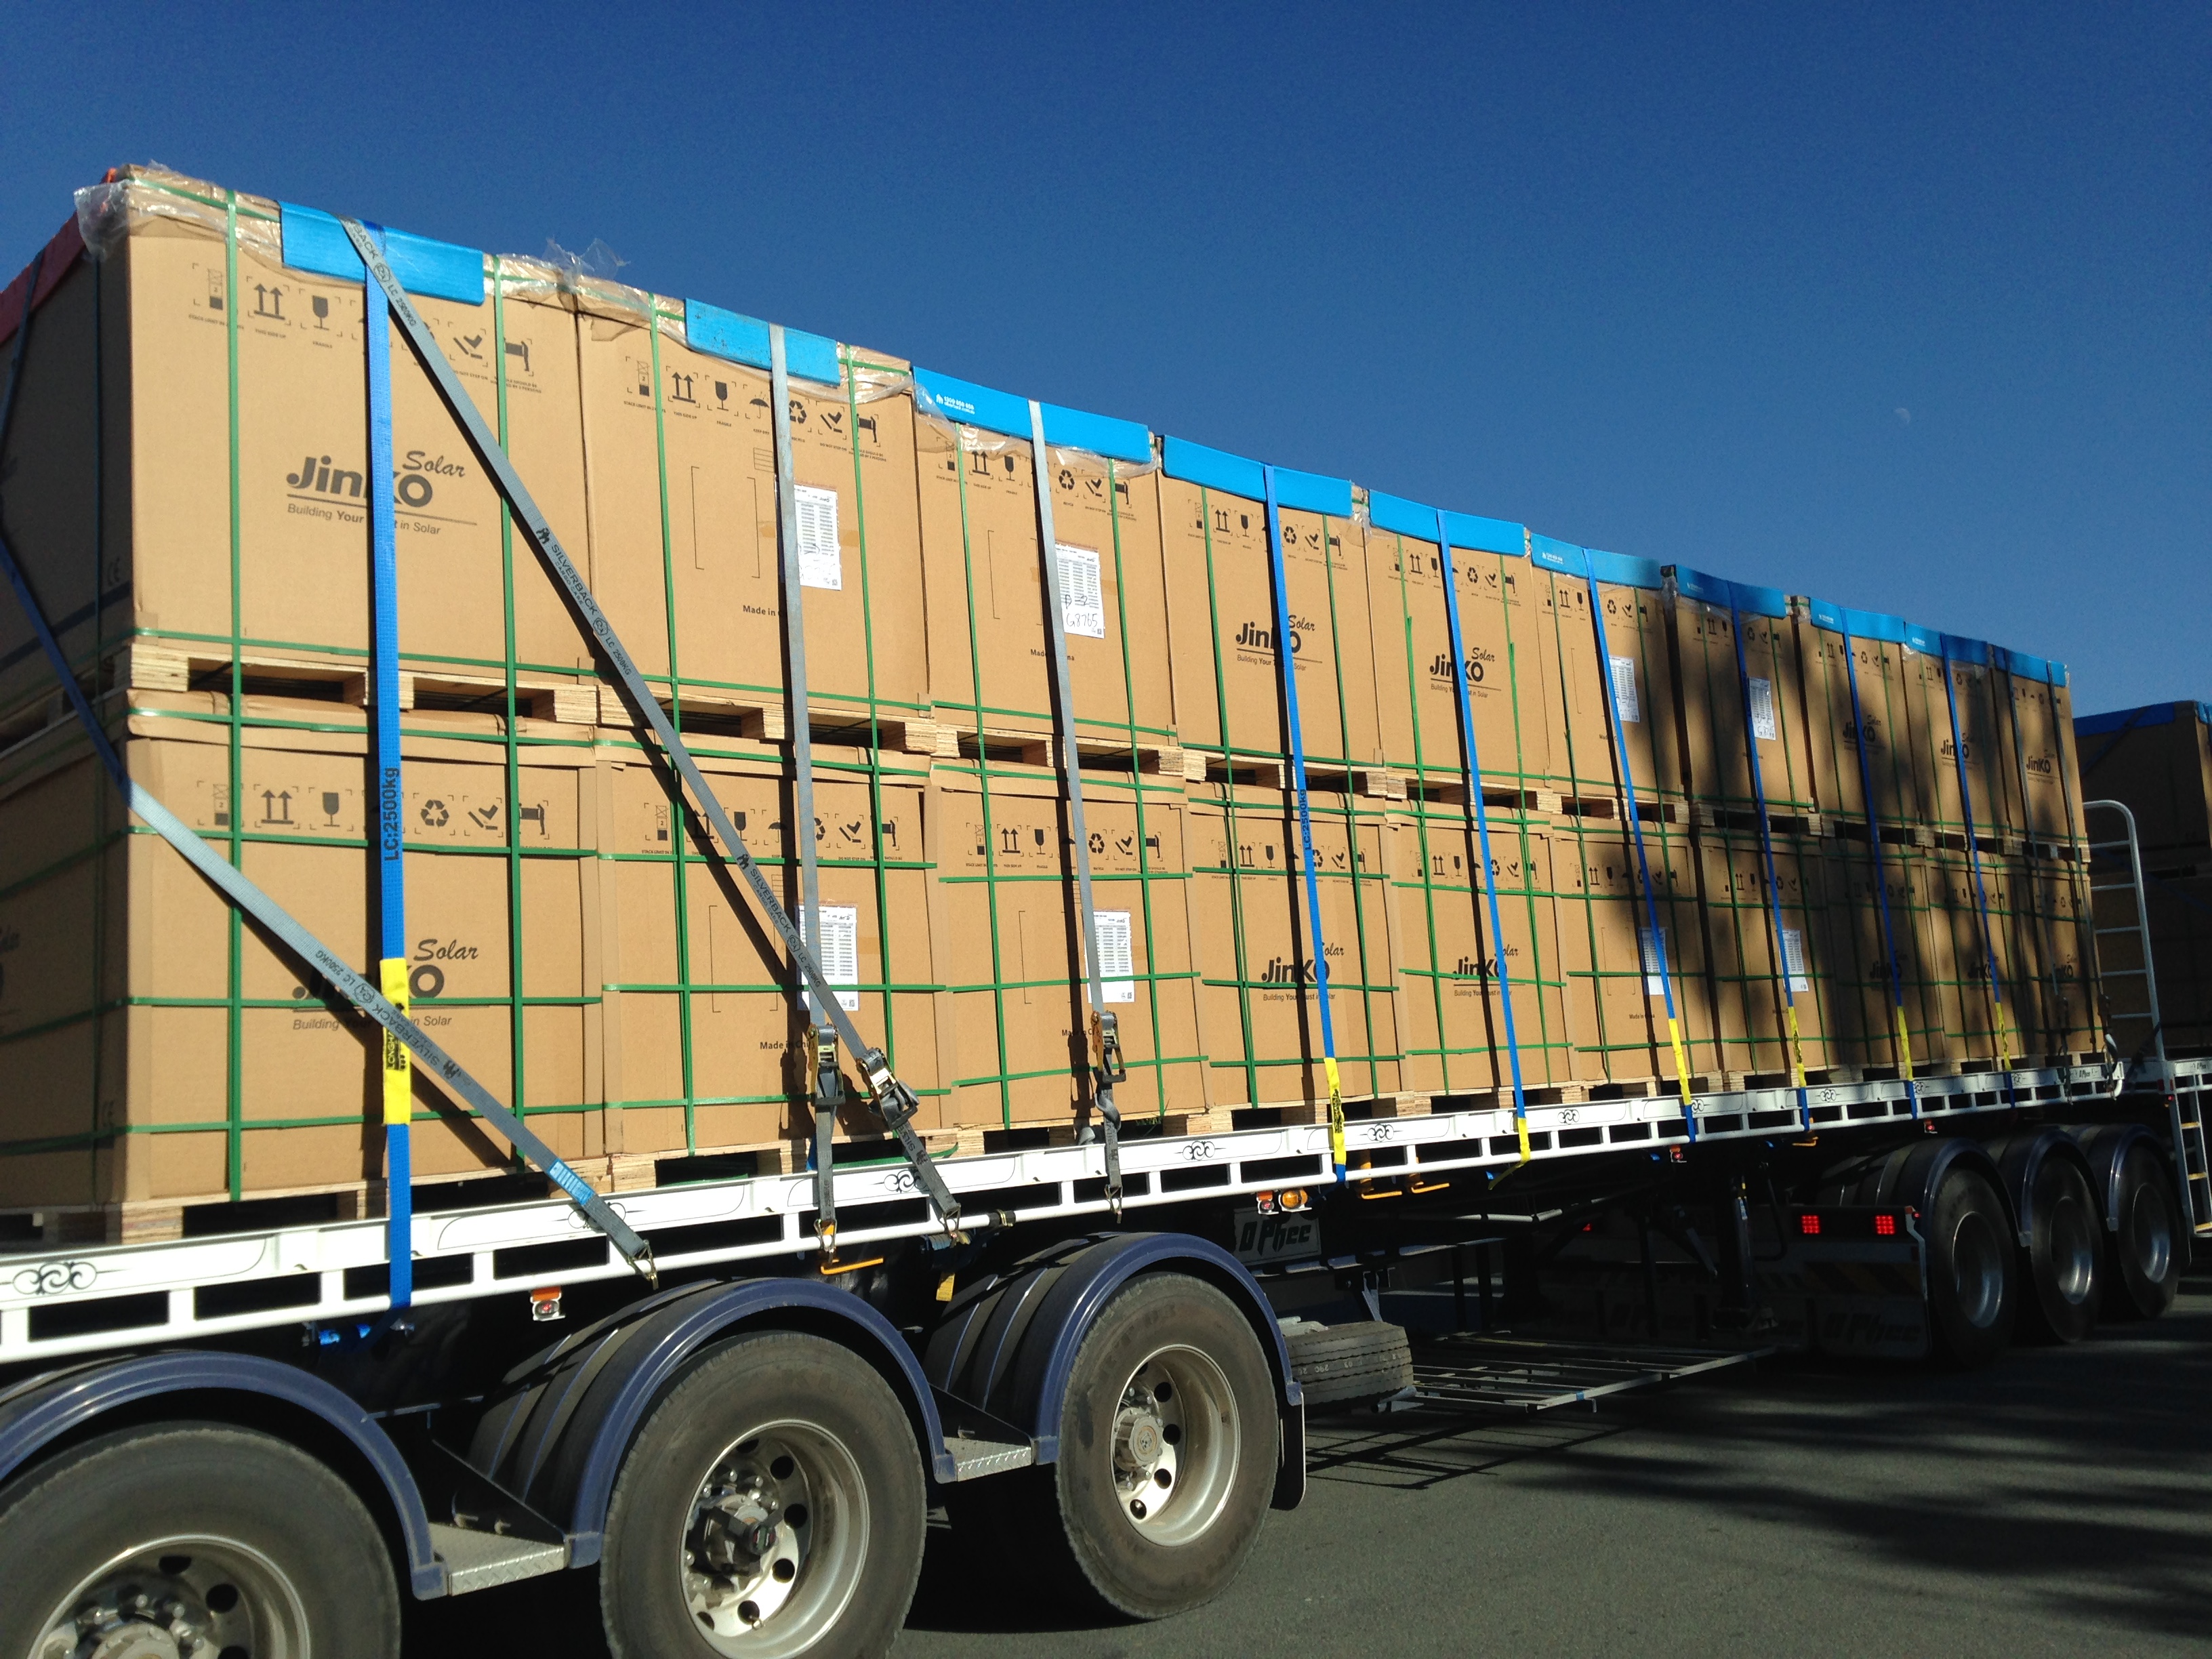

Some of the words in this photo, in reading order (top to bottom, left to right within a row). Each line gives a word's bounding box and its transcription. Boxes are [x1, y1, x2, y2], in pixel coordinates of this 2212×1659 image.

[402, 450, 466, 478] Solar
[286, 455, 433, 508] JinO
[287, 503, 332, 520] Building
[337, 510, 365, 525] Your
[413, 521, 441, 535] Solar
[554, 561, 571, 586] CARGO
[551, 544, 598, 616] SILVERBACK
[605, 636, 615, 648] LC
[612, 649, 631, 676] 2500KG
[743, 604, 766, 615] Made
[768, 608, 776, 617] in
[1288, 614, 1316, 632] Solar
[1235, 621, 1302, 653] JinO
[1237, 654, 1258, 665] Building
[1258, 657, 1272, 665] Your
[1471, 647, 1495, 663] Solar
[2026, 754, 2051, 774] JinKO
[380, 767, 400, 861] LC:2500kg
[750, 868, 793, 933] SILVERBACK
[798, 952, 806, 963] LC
[804, 963, 821, 988] 2500KG
[413, 939, 479, 962] Solar
[1322, 941, 1345, 956] olar
[293, 1019, 339, 1031] Building
[424, 1015, 452, 1027] Solar
[342, 974, 355, 986] LC
[371, 1003, 441, 1067] SILVERBACK
[760, 1040, 784, 1050] Made
